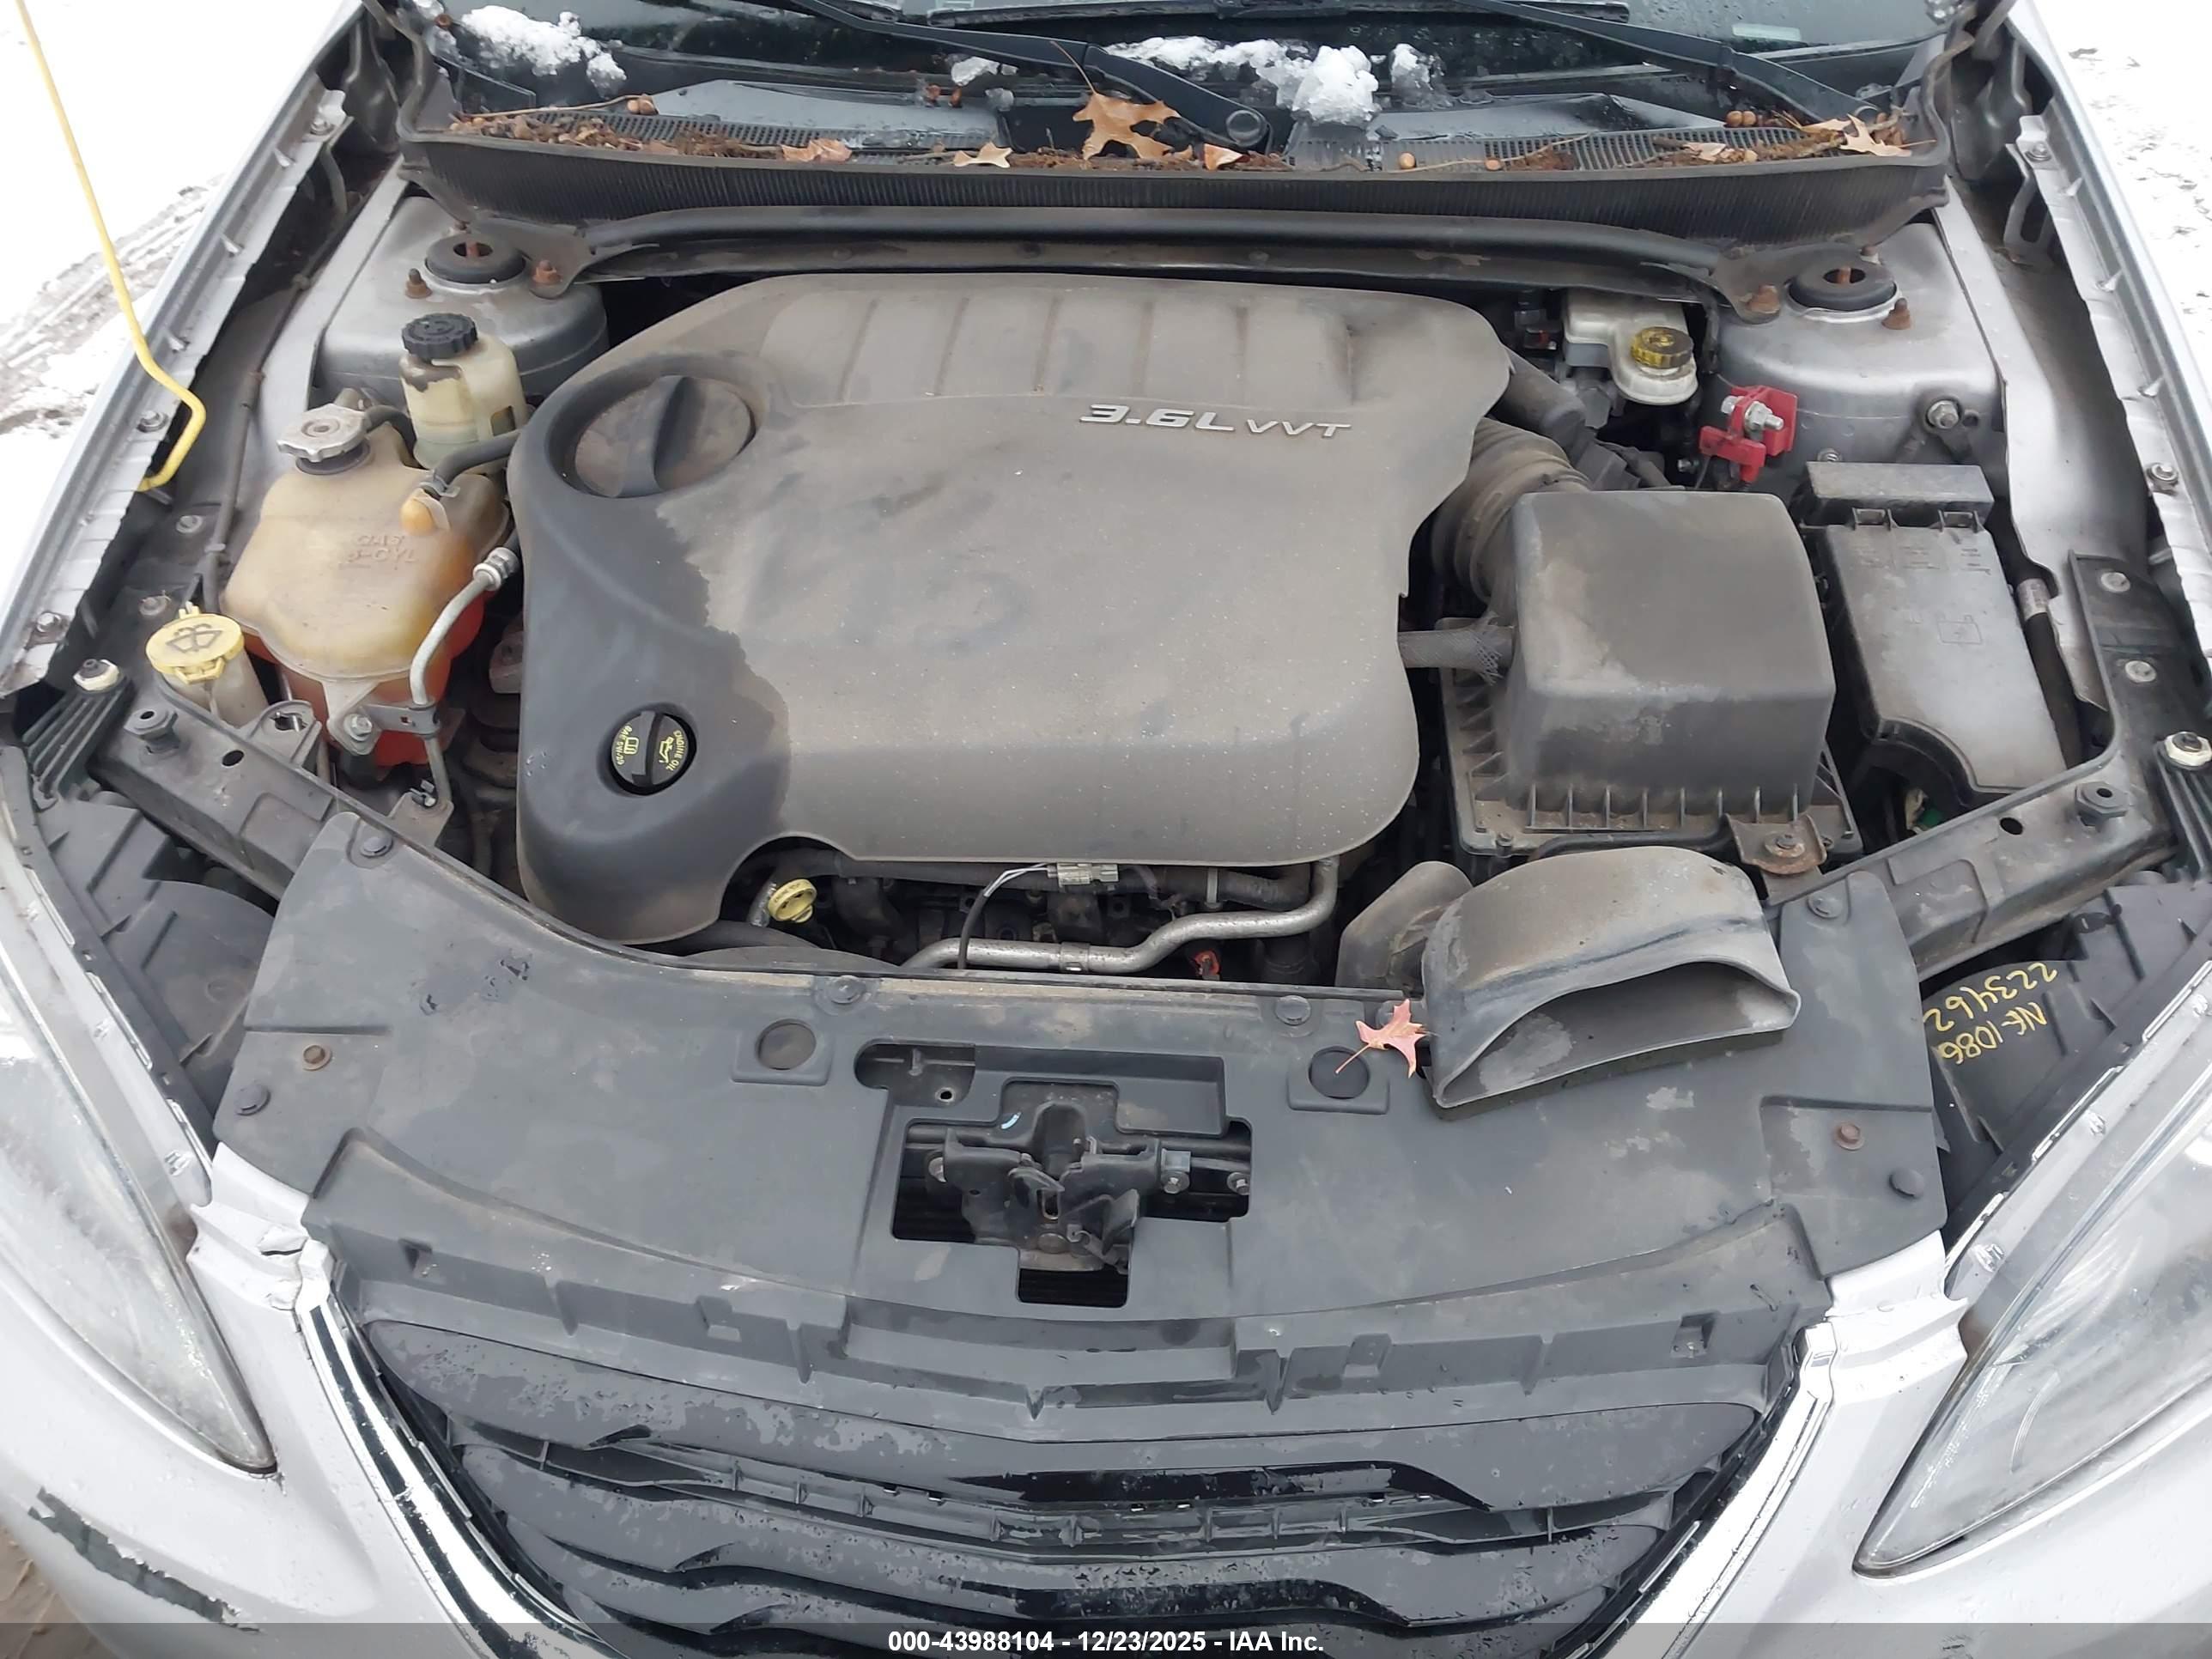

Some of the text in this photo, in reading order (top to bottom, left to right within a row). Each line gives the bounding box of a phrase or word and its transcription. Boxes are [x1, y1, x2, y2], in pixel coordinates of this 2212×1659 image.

[1079, 404, 1352, 437] 3.6L VVT
[665, 759, 680, 771] OIL
[1923, 962, 2058, 1032] 223462
